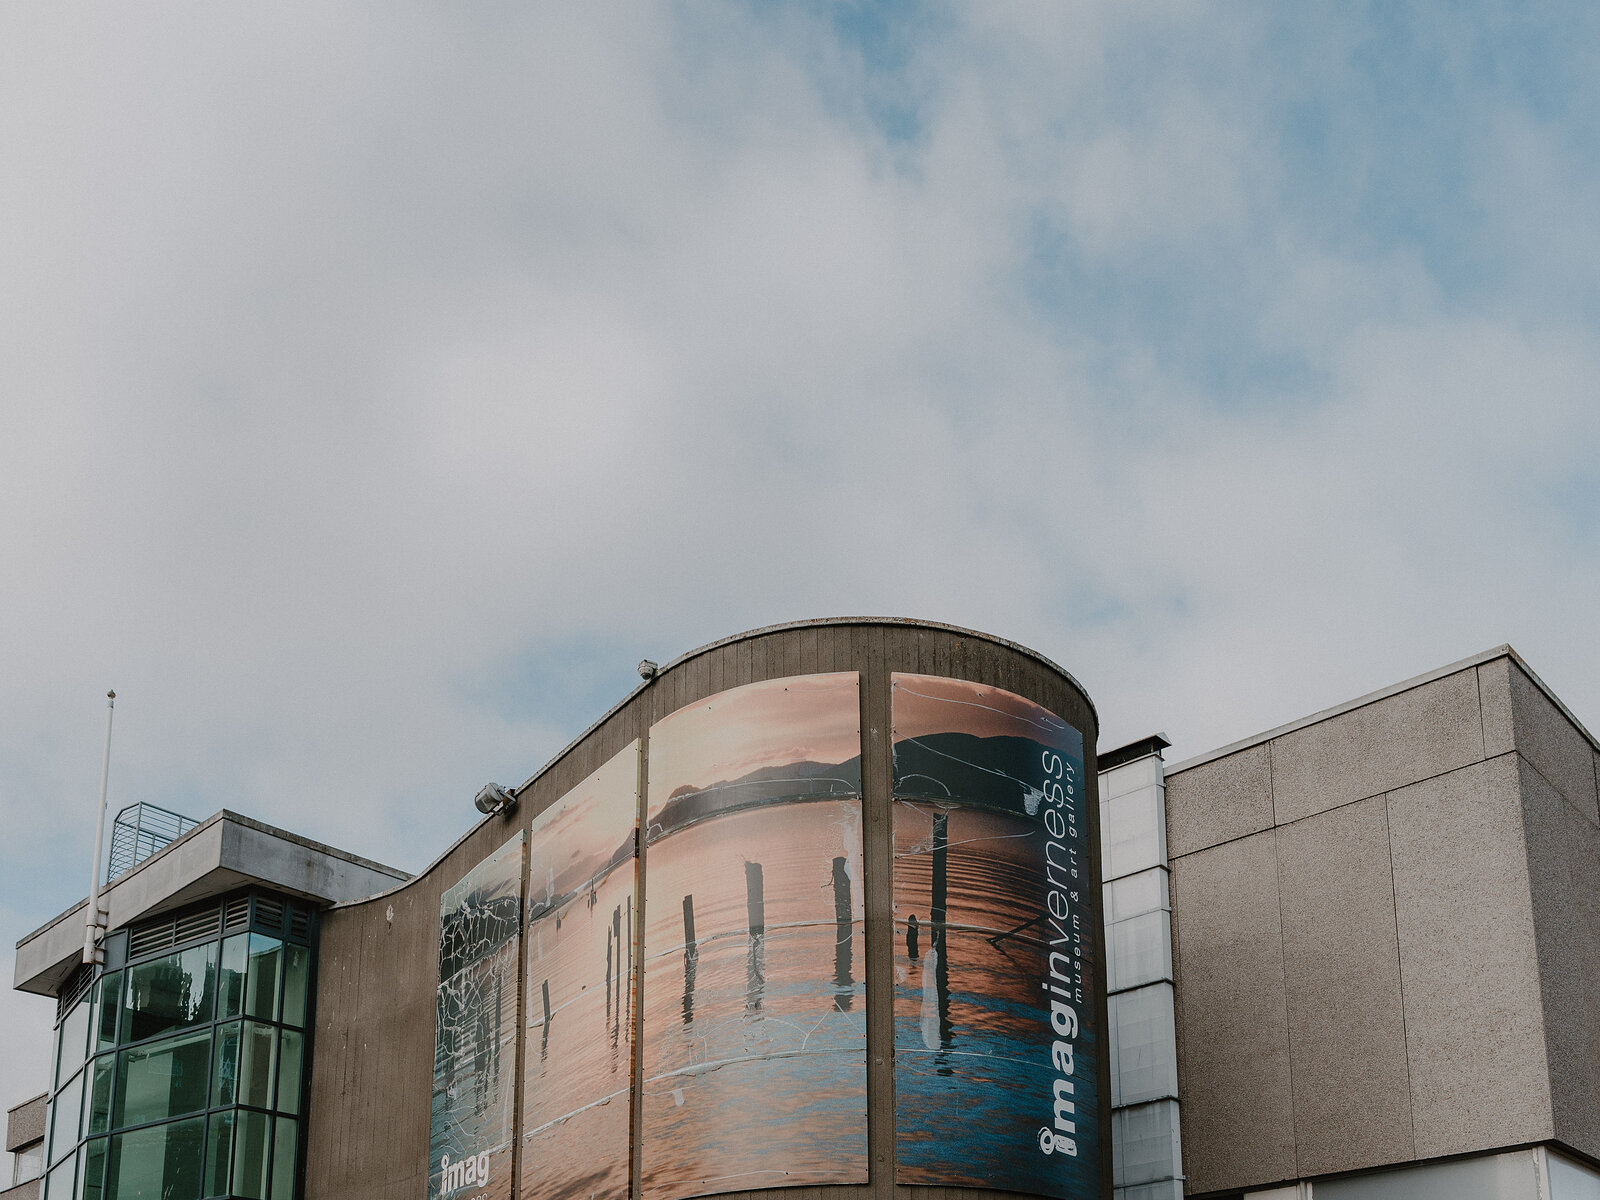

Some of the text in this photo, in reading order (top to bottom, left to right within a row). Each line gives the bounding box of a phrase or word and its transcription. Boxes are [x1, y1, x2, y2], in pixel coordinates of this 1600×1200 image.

[1038, 751, 1078, 1157] imaginverness
[1066, 761, 1082, 1004] museum & art gallery
[440, 1150, 490, 1195] imag
